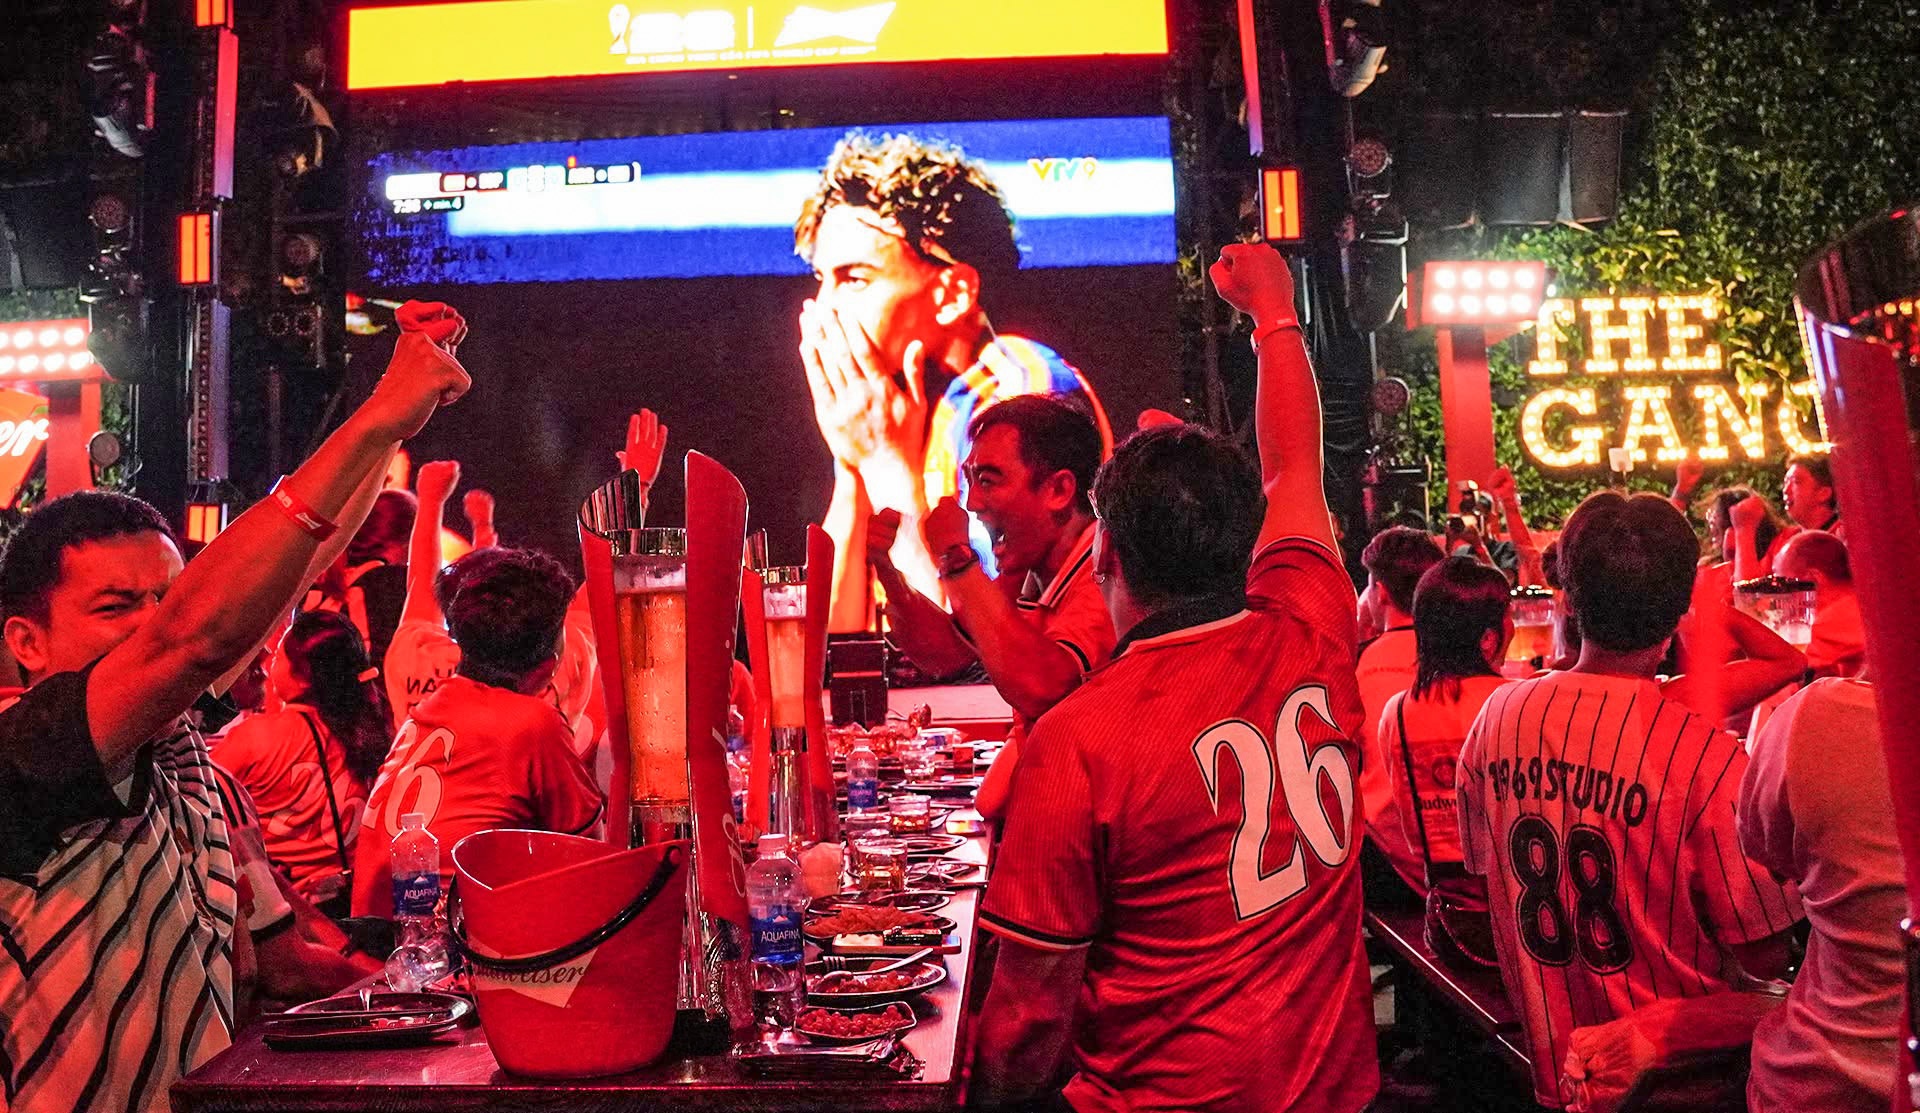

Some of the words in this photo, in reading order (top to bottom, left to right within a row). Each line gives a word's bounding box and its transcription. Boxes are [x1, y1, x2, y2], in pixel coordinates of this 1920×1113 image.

[1529, 295, 1724, 376] THE
[361, 717, 456, 840] 26
[1190, 683, 1355, 924] 26
[1488, 757, 1649, 827] 1969STUDIO
[403, 887, 438, 900] AQUAFINA
[1508, 812, 1635, 975] 88
[760, 928, 801, 944] AQUAFINA
